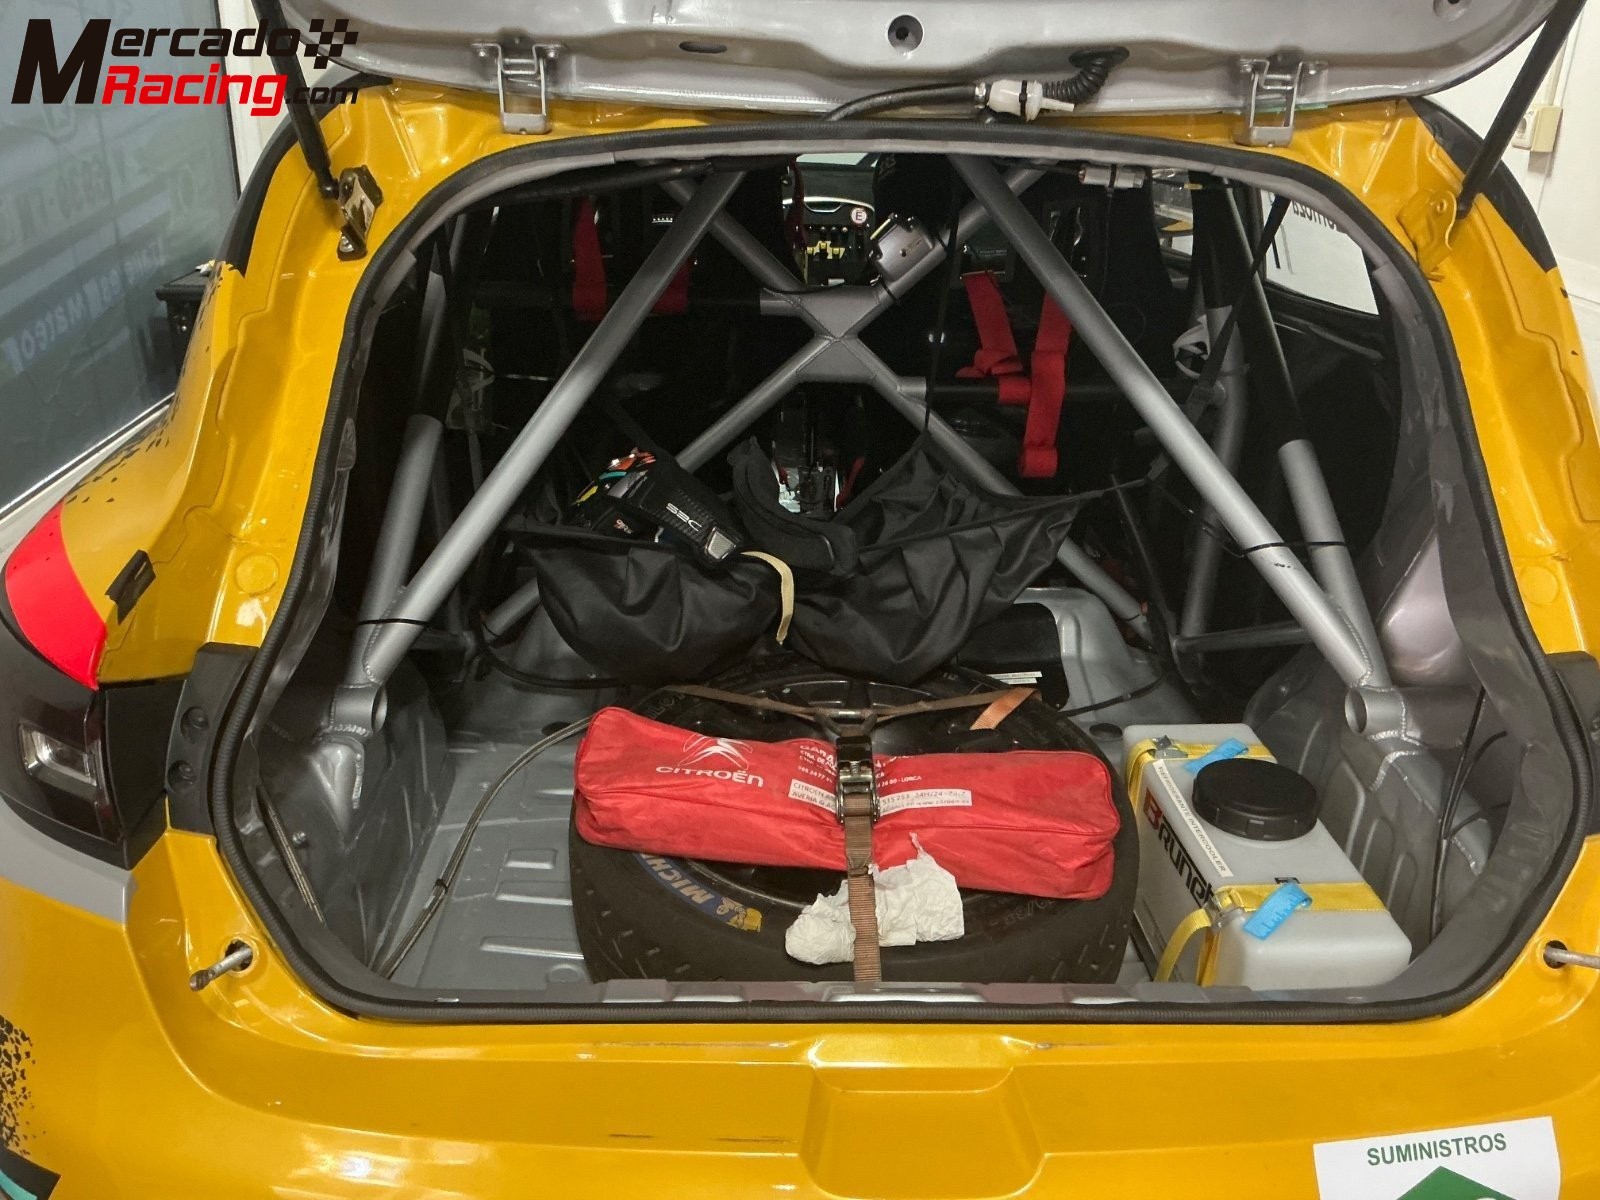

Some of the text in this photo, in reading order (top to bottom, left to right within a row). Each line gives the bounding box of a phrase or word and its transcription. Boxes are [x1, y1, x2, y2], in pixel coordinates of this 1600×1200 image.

[655, 766, 764, 788] CITROËN
[1189, 818, 1226, 872] INTERCOOLER
[640, 853, 715, 905] MICH
[1367, 1132, 1507, 1166] SUMINISTROS
